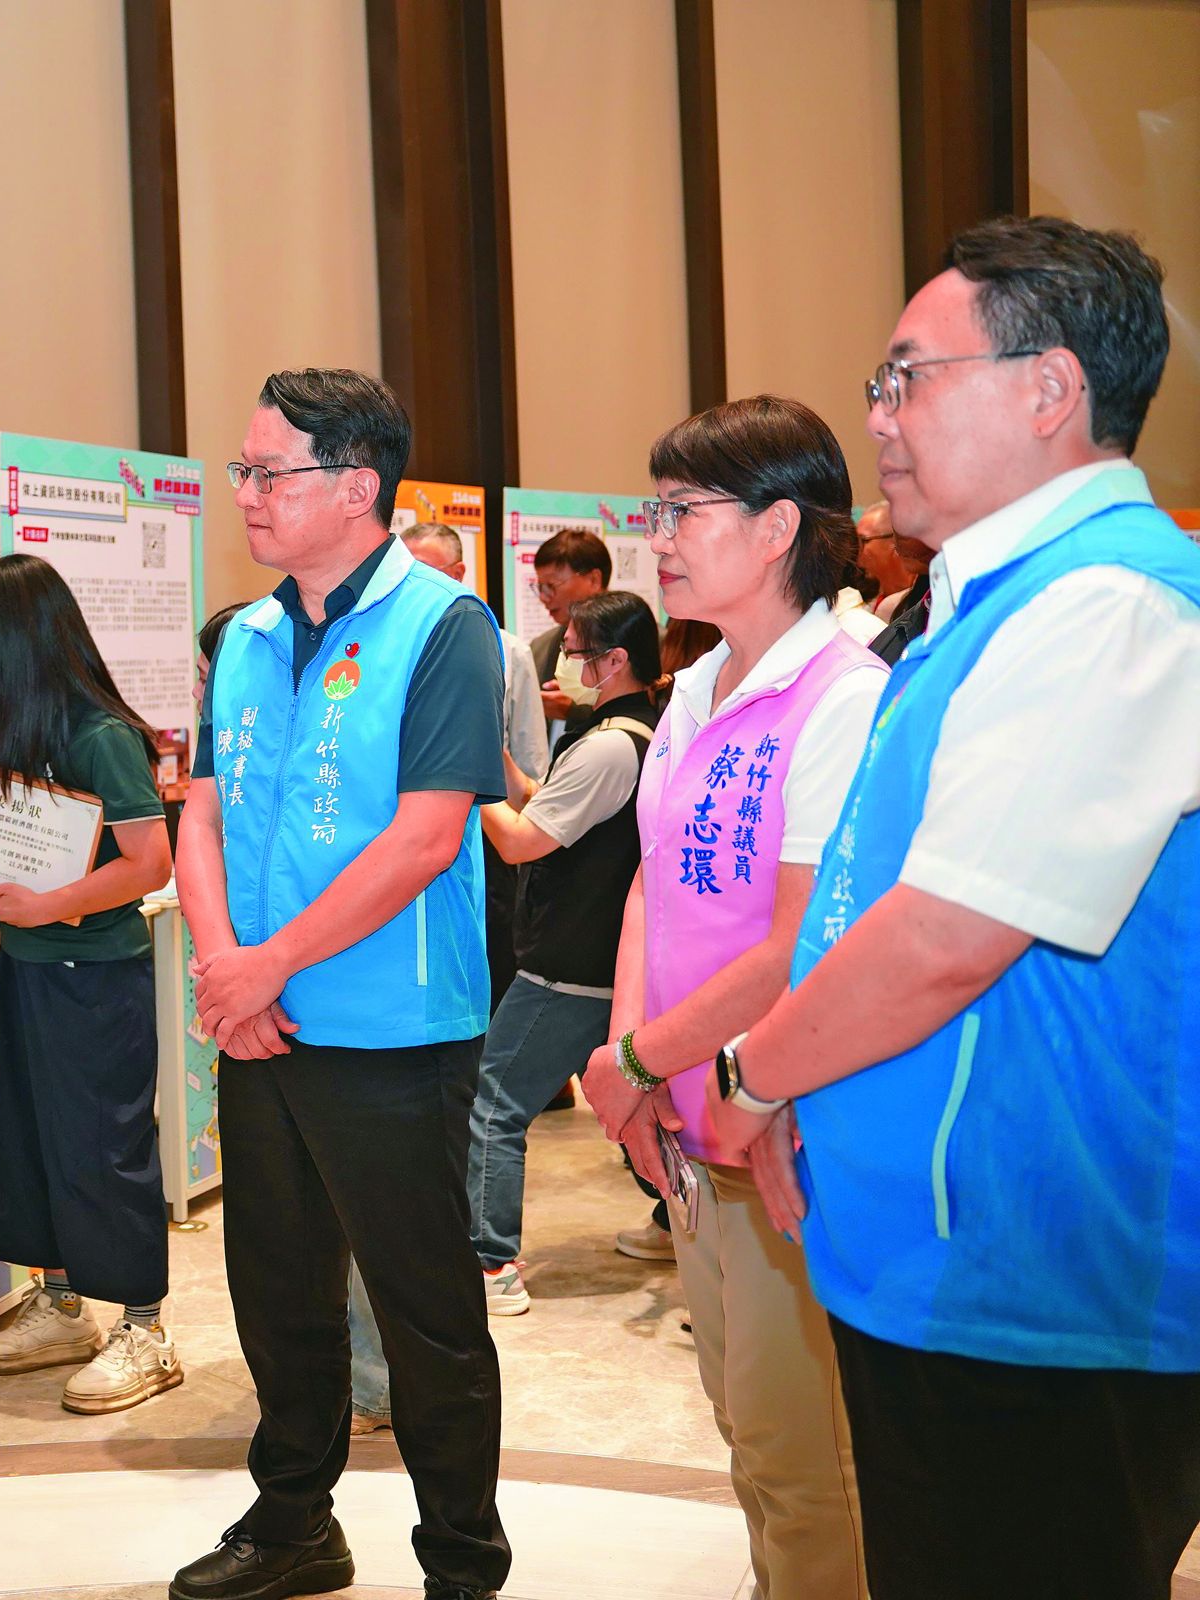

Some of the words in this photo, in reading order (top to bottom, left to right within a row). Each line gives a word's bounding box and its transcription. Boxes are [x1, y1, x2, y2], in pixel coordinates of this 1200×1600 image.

[228, 705, 259, 806] 副秘書長
[311, 703, 345, 845] 新竹縣政府
[678, 743, 745, 895] 蔡志環
[731, 733, 781, 885] 新竹縣議員
